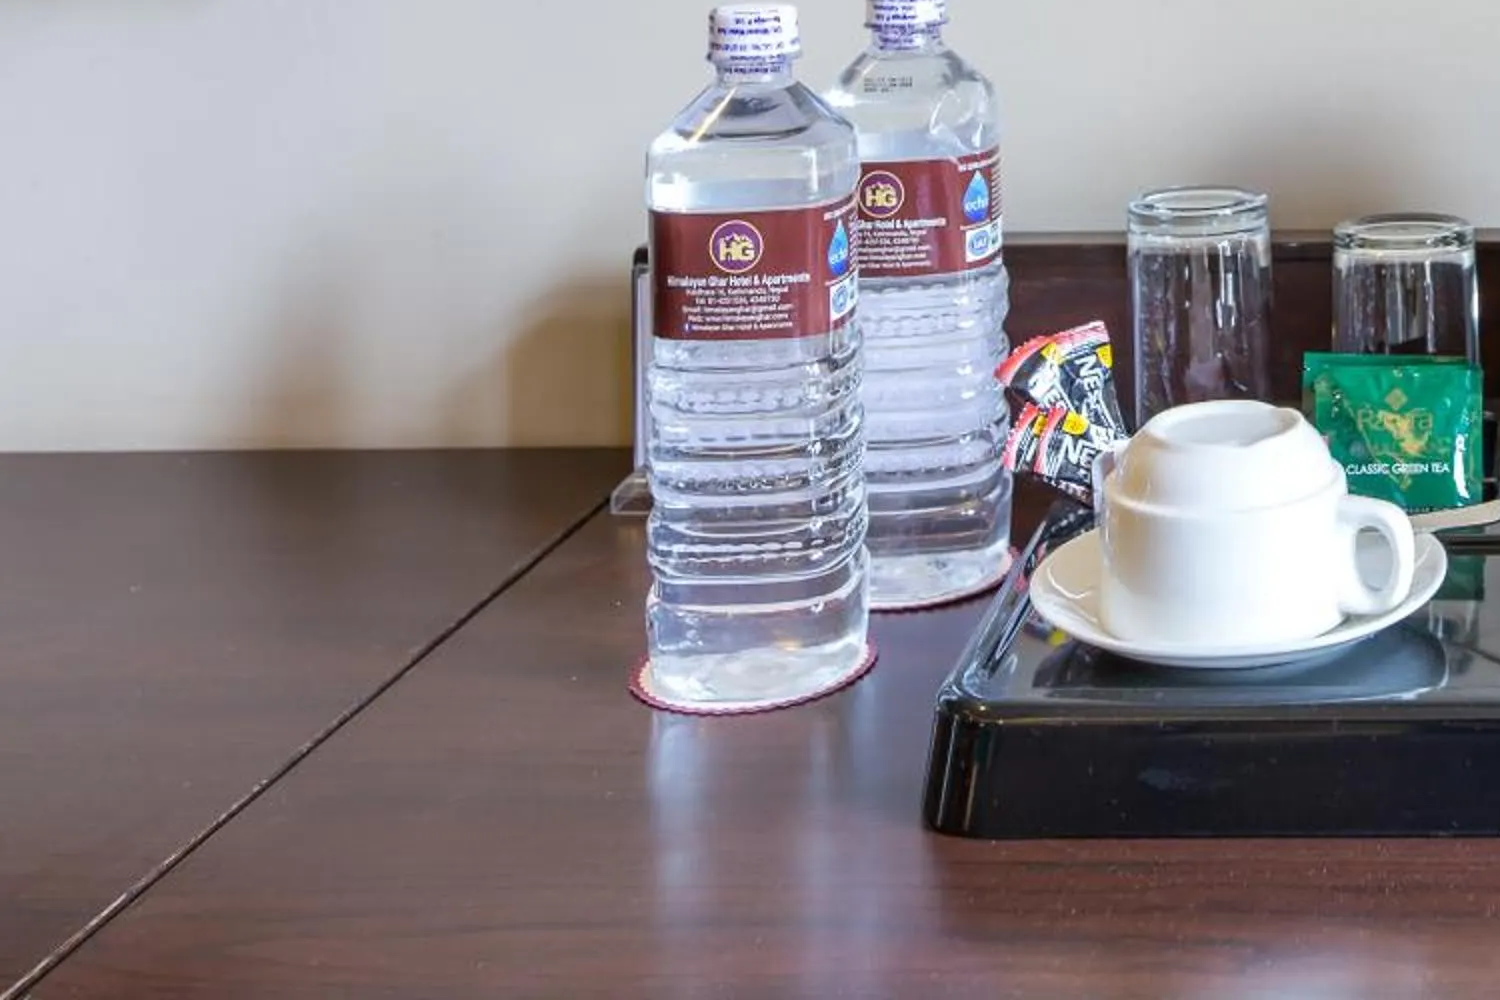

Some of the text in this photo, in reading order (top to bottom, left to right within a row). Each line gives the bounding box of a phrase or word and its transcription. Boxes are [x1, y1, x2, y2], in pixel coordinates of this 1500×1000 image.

[865, 183, 897, 208] HG
[719, 235, 754, 262] HG
[729, 275, 752, 287] Hotel
[754, 274, 760, 286] &
[762, 272, 811, 287] Apartments
[1345, 461, 1450, 476] CLASSIC GREEN TEA
